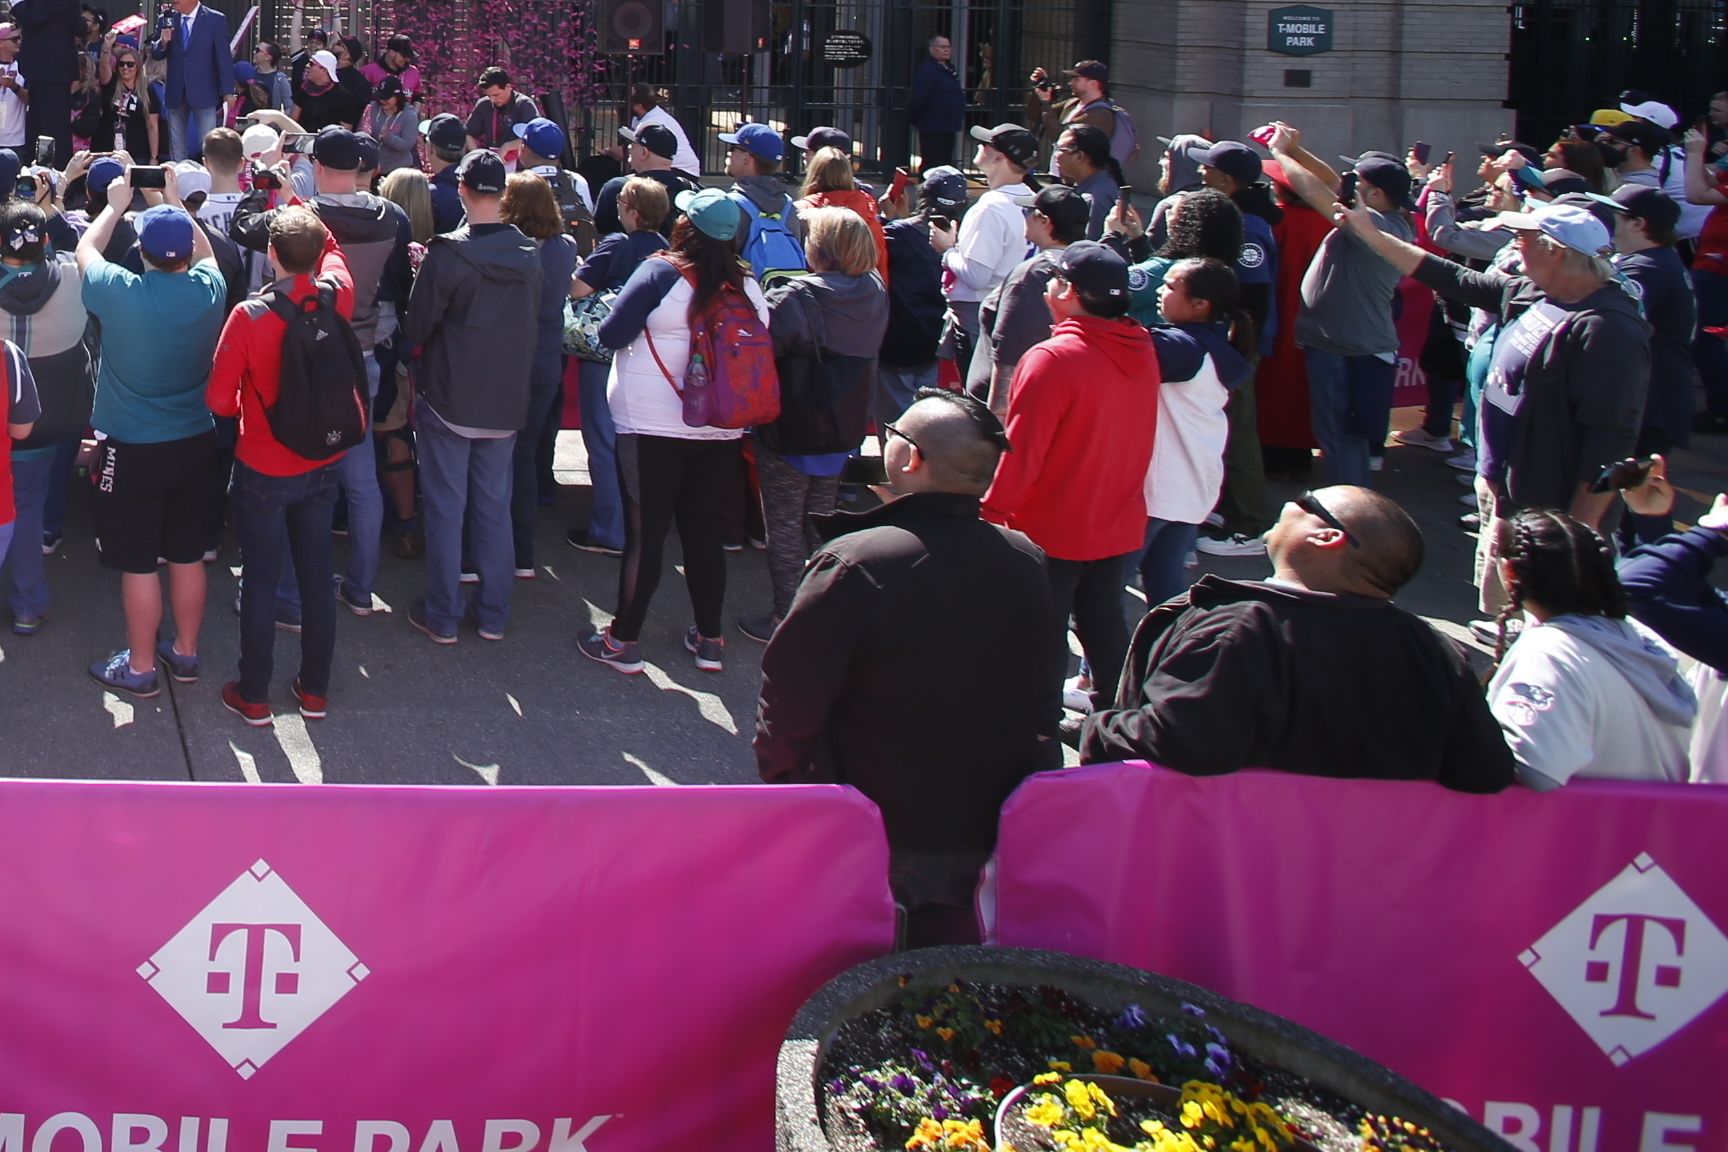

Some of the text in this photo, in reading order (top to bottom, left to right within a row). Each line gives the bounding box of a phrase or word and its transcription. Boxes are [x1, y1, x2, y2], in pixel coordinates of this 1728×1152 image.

[1276, 23, 1326, 35] T-MOBILE
[1286, 36, 1314, 47] PARK
[100, 446, 116, 493] MINES
